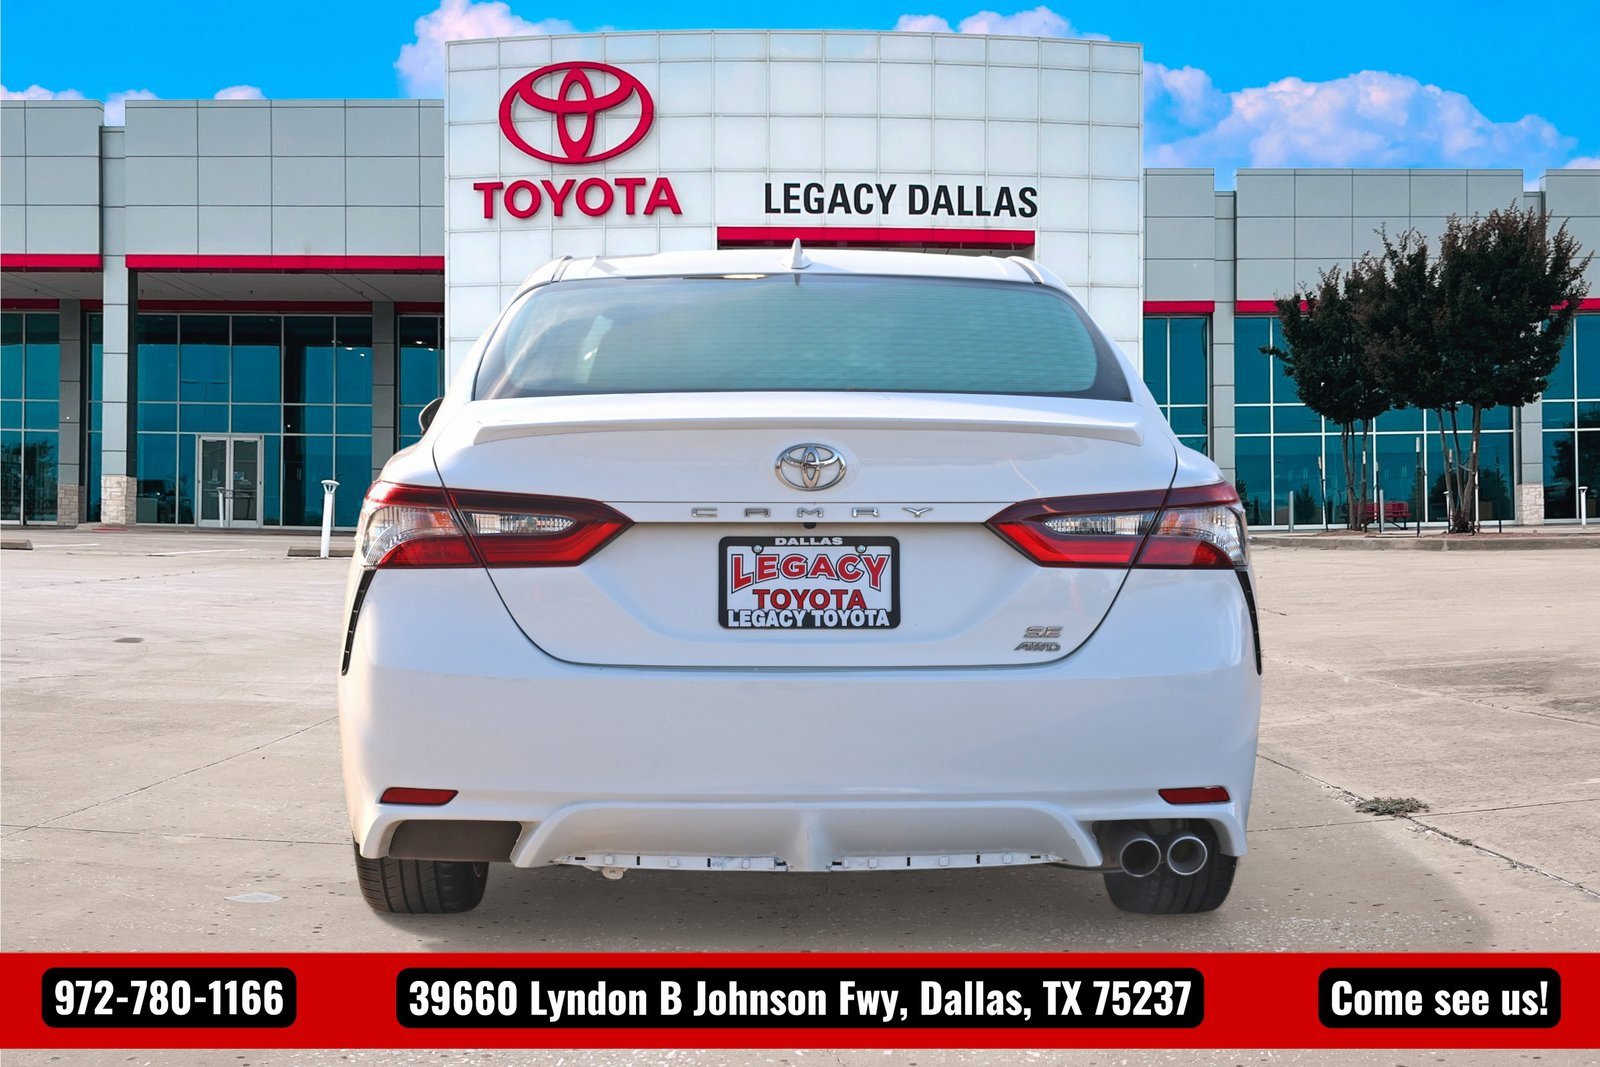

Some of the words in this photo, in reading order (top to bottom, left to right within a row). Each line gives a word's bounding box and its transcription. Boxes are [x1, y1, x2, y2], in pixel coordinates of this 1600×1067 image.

[474, 177, 682, 218] TOYOTA
[765, 183, 897, 215] LEGACY
[908, 185, 1038, 218] DALLAS
[691, 507, 934, 518] CAMRY
[774, 537, 843, 546] DALLAS
[731, 554, 889, 593] LEGACY
[752, 589, 867, 610] TOYOTA
[727, 610, 806, 628] LEGACY
[811, 610, 890, 627] TOYOTA
[1024, 626, 1063, 638] SE
[1014, 642, 1061, 652] AWD
